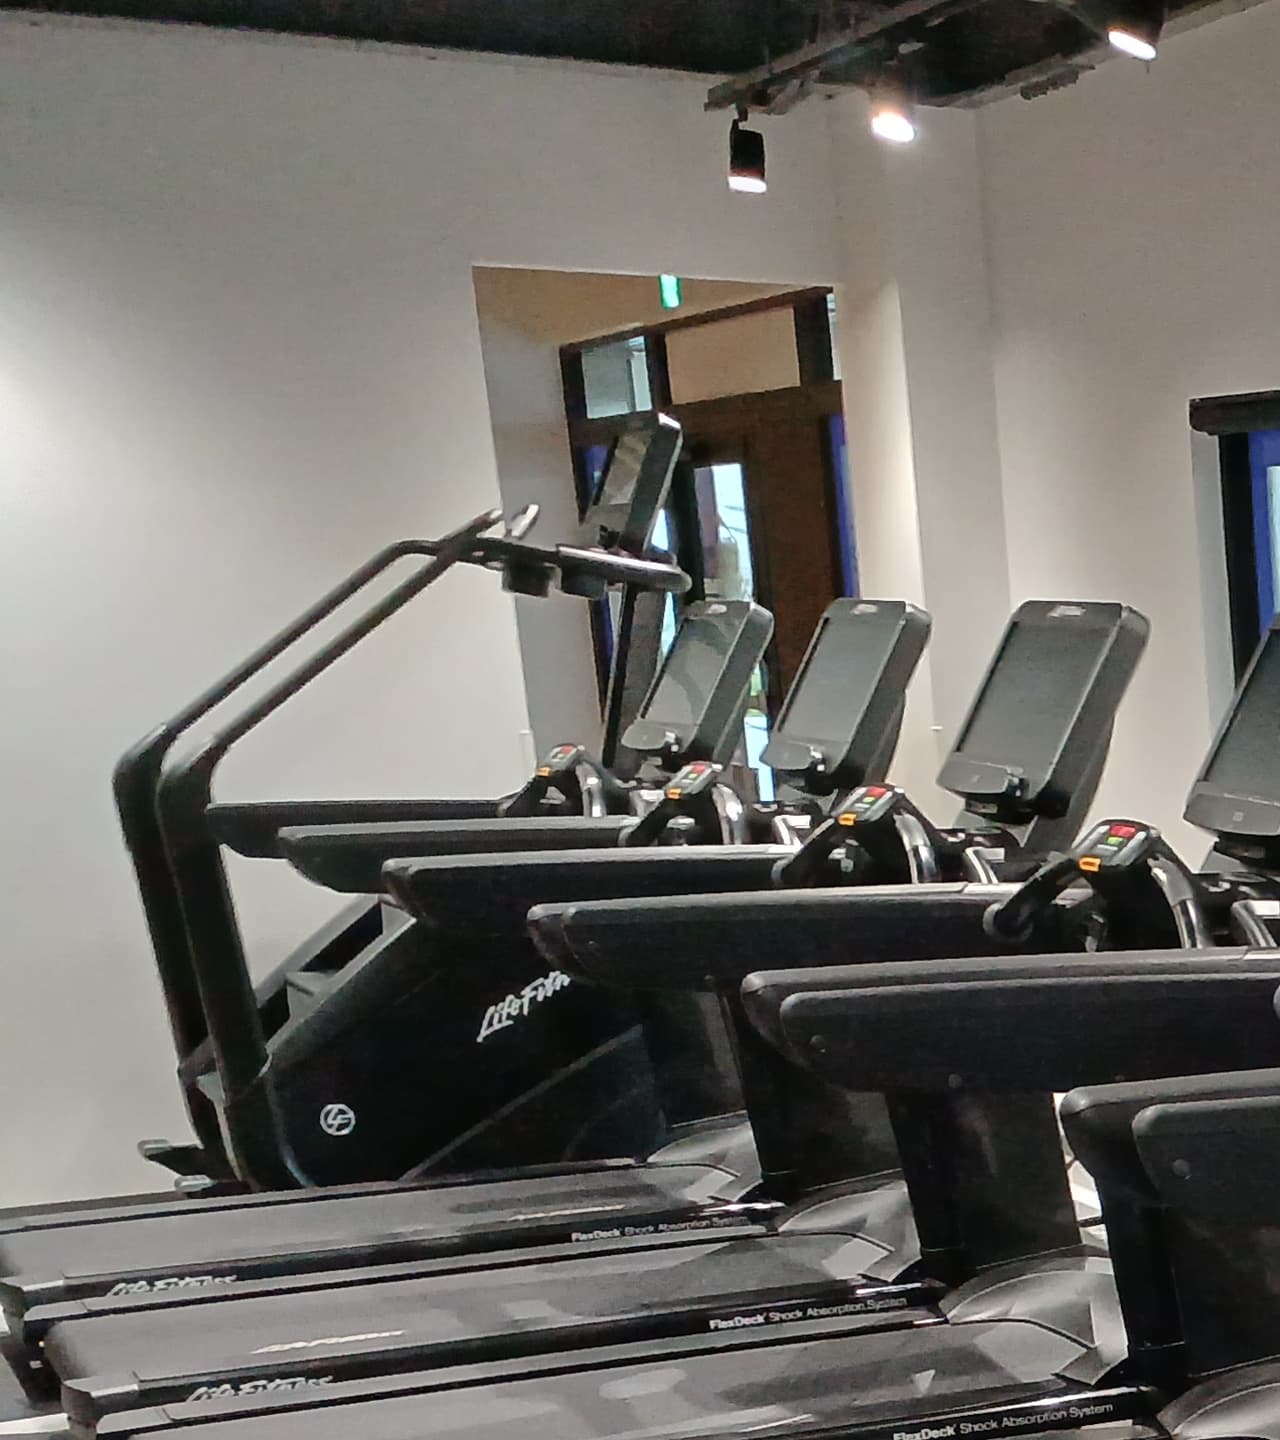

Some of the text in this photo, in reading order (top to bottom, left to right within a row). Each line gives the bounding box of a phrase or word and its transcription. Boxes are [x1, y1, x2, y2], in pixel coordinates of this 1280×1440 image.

[960, 1419, 998, 1434] Shock
[1001, 1409, 1067, 1427] Absorption
[1069, 1402, 1113, 1419] System
